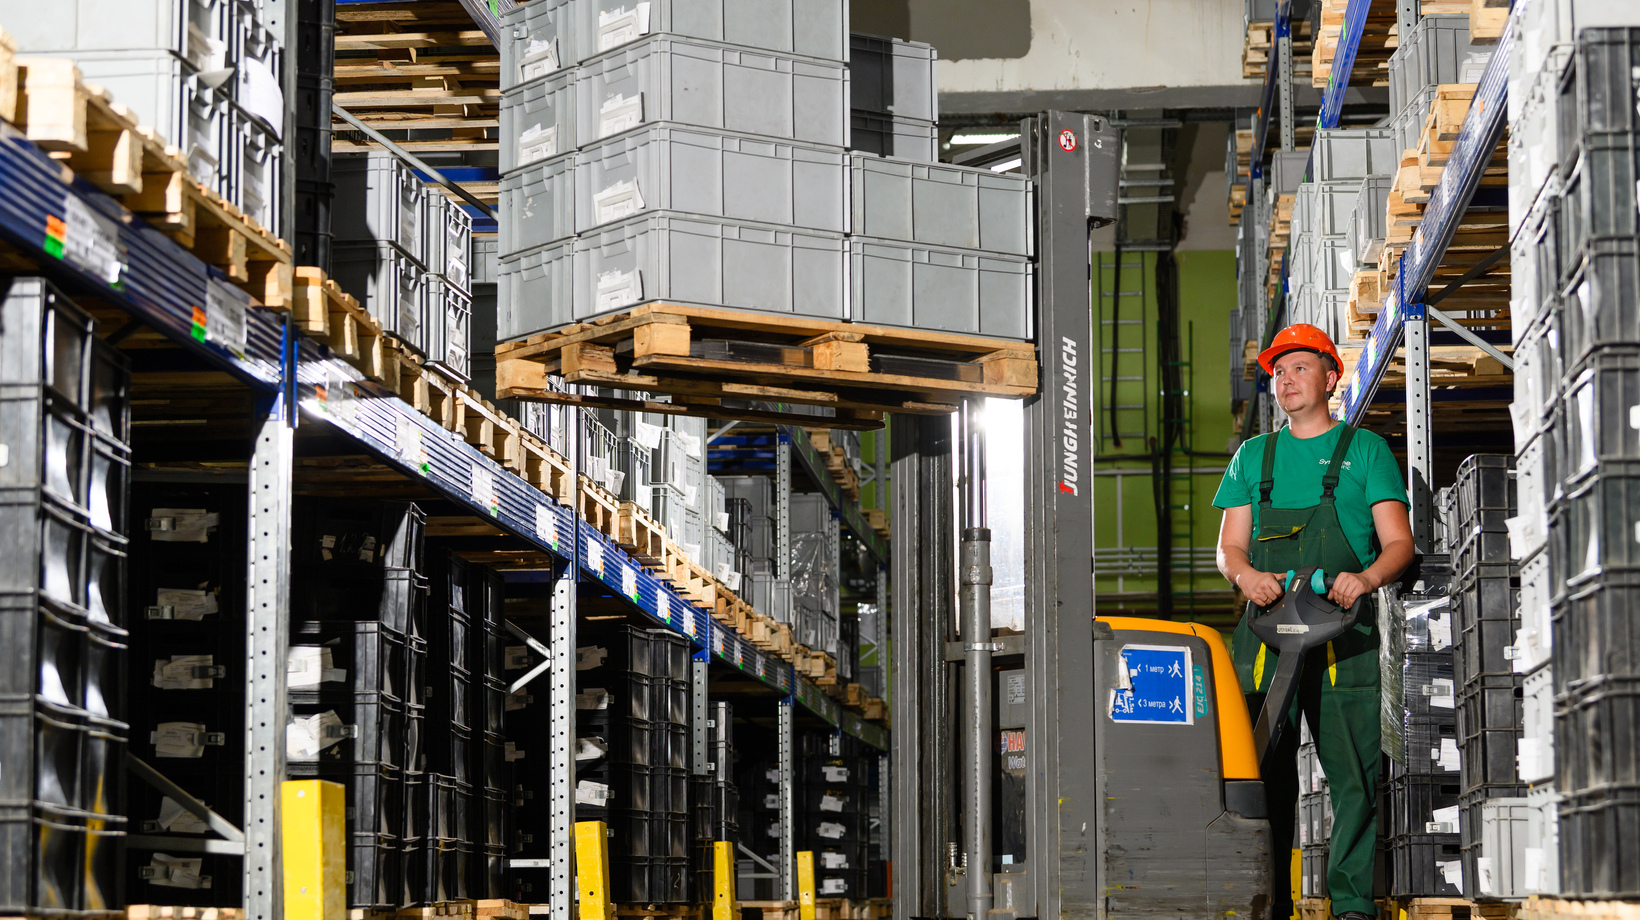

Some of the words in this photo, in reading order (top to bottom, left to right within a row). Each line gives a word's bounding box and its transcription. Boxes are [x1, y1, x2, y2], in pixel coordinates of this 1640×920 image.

[1058, 336, 1079, 497] JUNGHEINRICH
[1150, 666, 1165, 674] метр
[1195, 675, 1203, 694] 214
[1143, 699, 1148, 707] 3
[1148, 700, 1166, 708] метра
[1008, 731, 1026, 752] HA
